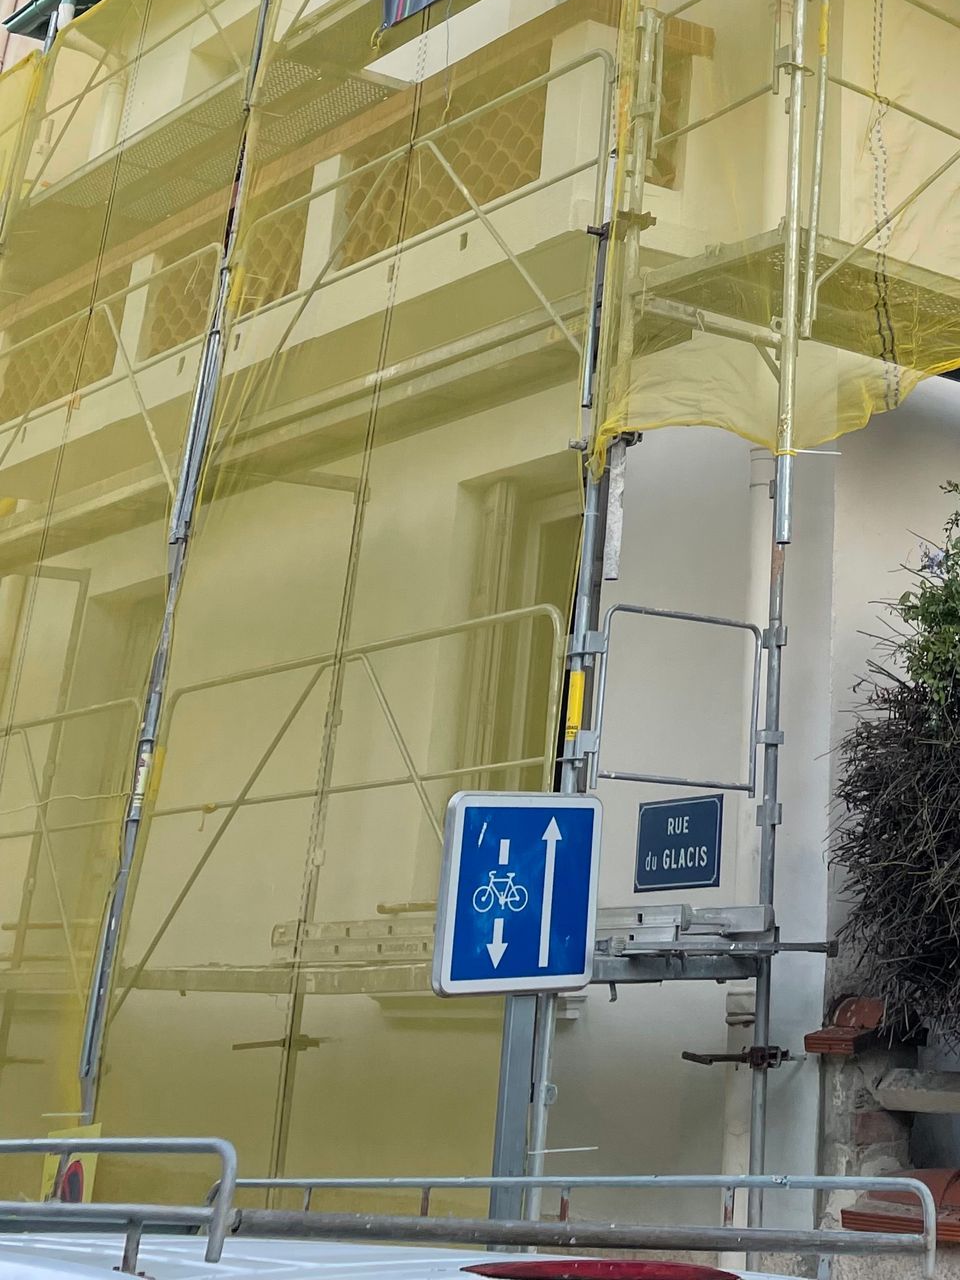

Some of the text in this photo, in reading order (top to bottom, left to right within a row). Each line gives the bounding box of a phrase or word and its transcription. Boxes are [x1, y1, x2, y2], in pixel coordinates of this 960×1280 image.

[667, 816, 690, 835] RUE
[645, 845, 708, 871] du GLACIS
